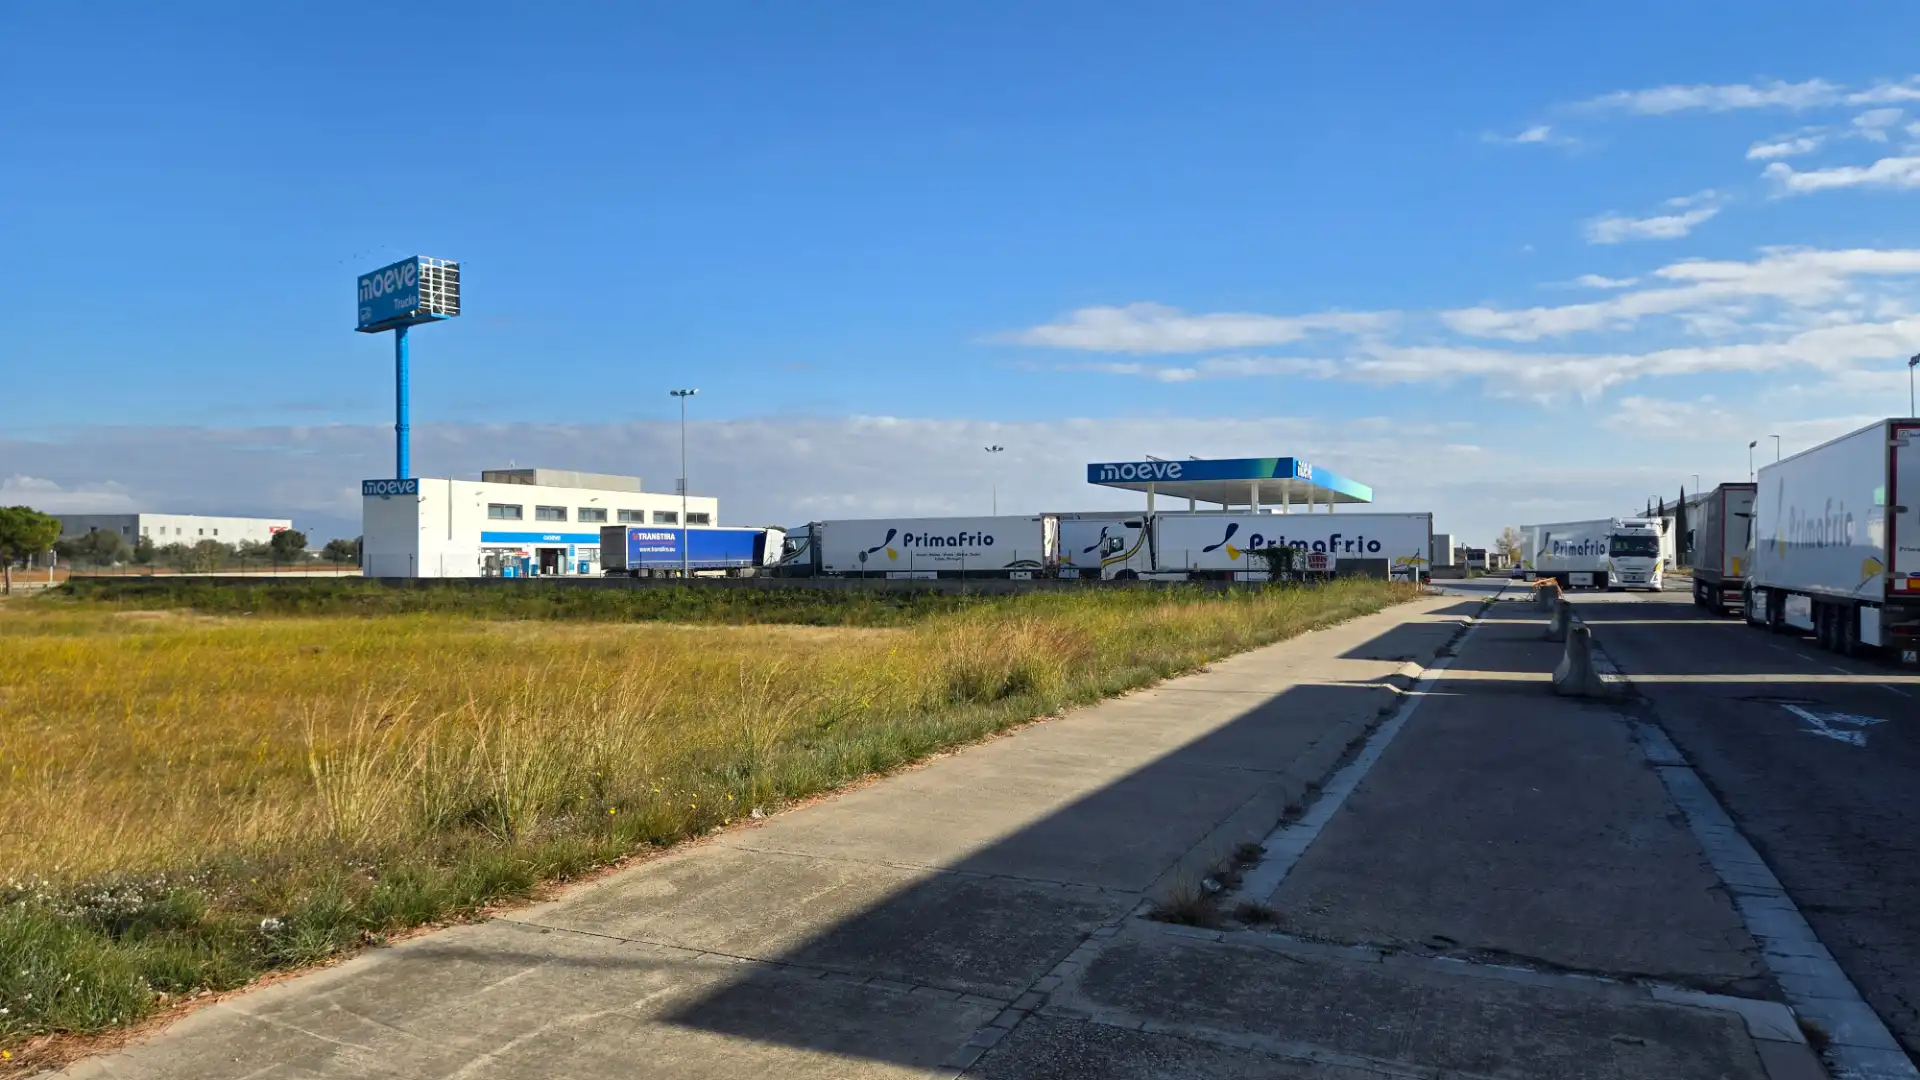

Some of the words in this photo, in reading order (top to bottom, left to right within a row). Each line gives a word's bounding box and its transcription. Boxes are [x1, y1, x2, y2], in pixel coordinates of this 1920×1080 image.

[360, 262, 416, 302] moeve
[393, 295, 417, 310] Trucks
[1100, 462, 1182, 480] moeve
[363, 480, 416, 494] moeve
[1788, 497, 1854, 550] PrimaFrio
[637, 533, 675, 541] TRANSTIRA
[903, 531, 994, 547] PrimaFrio
[1249, 533, 1381, 553] PrimaFrio
[1553, 538, 1606, 556] PrimaFrio
